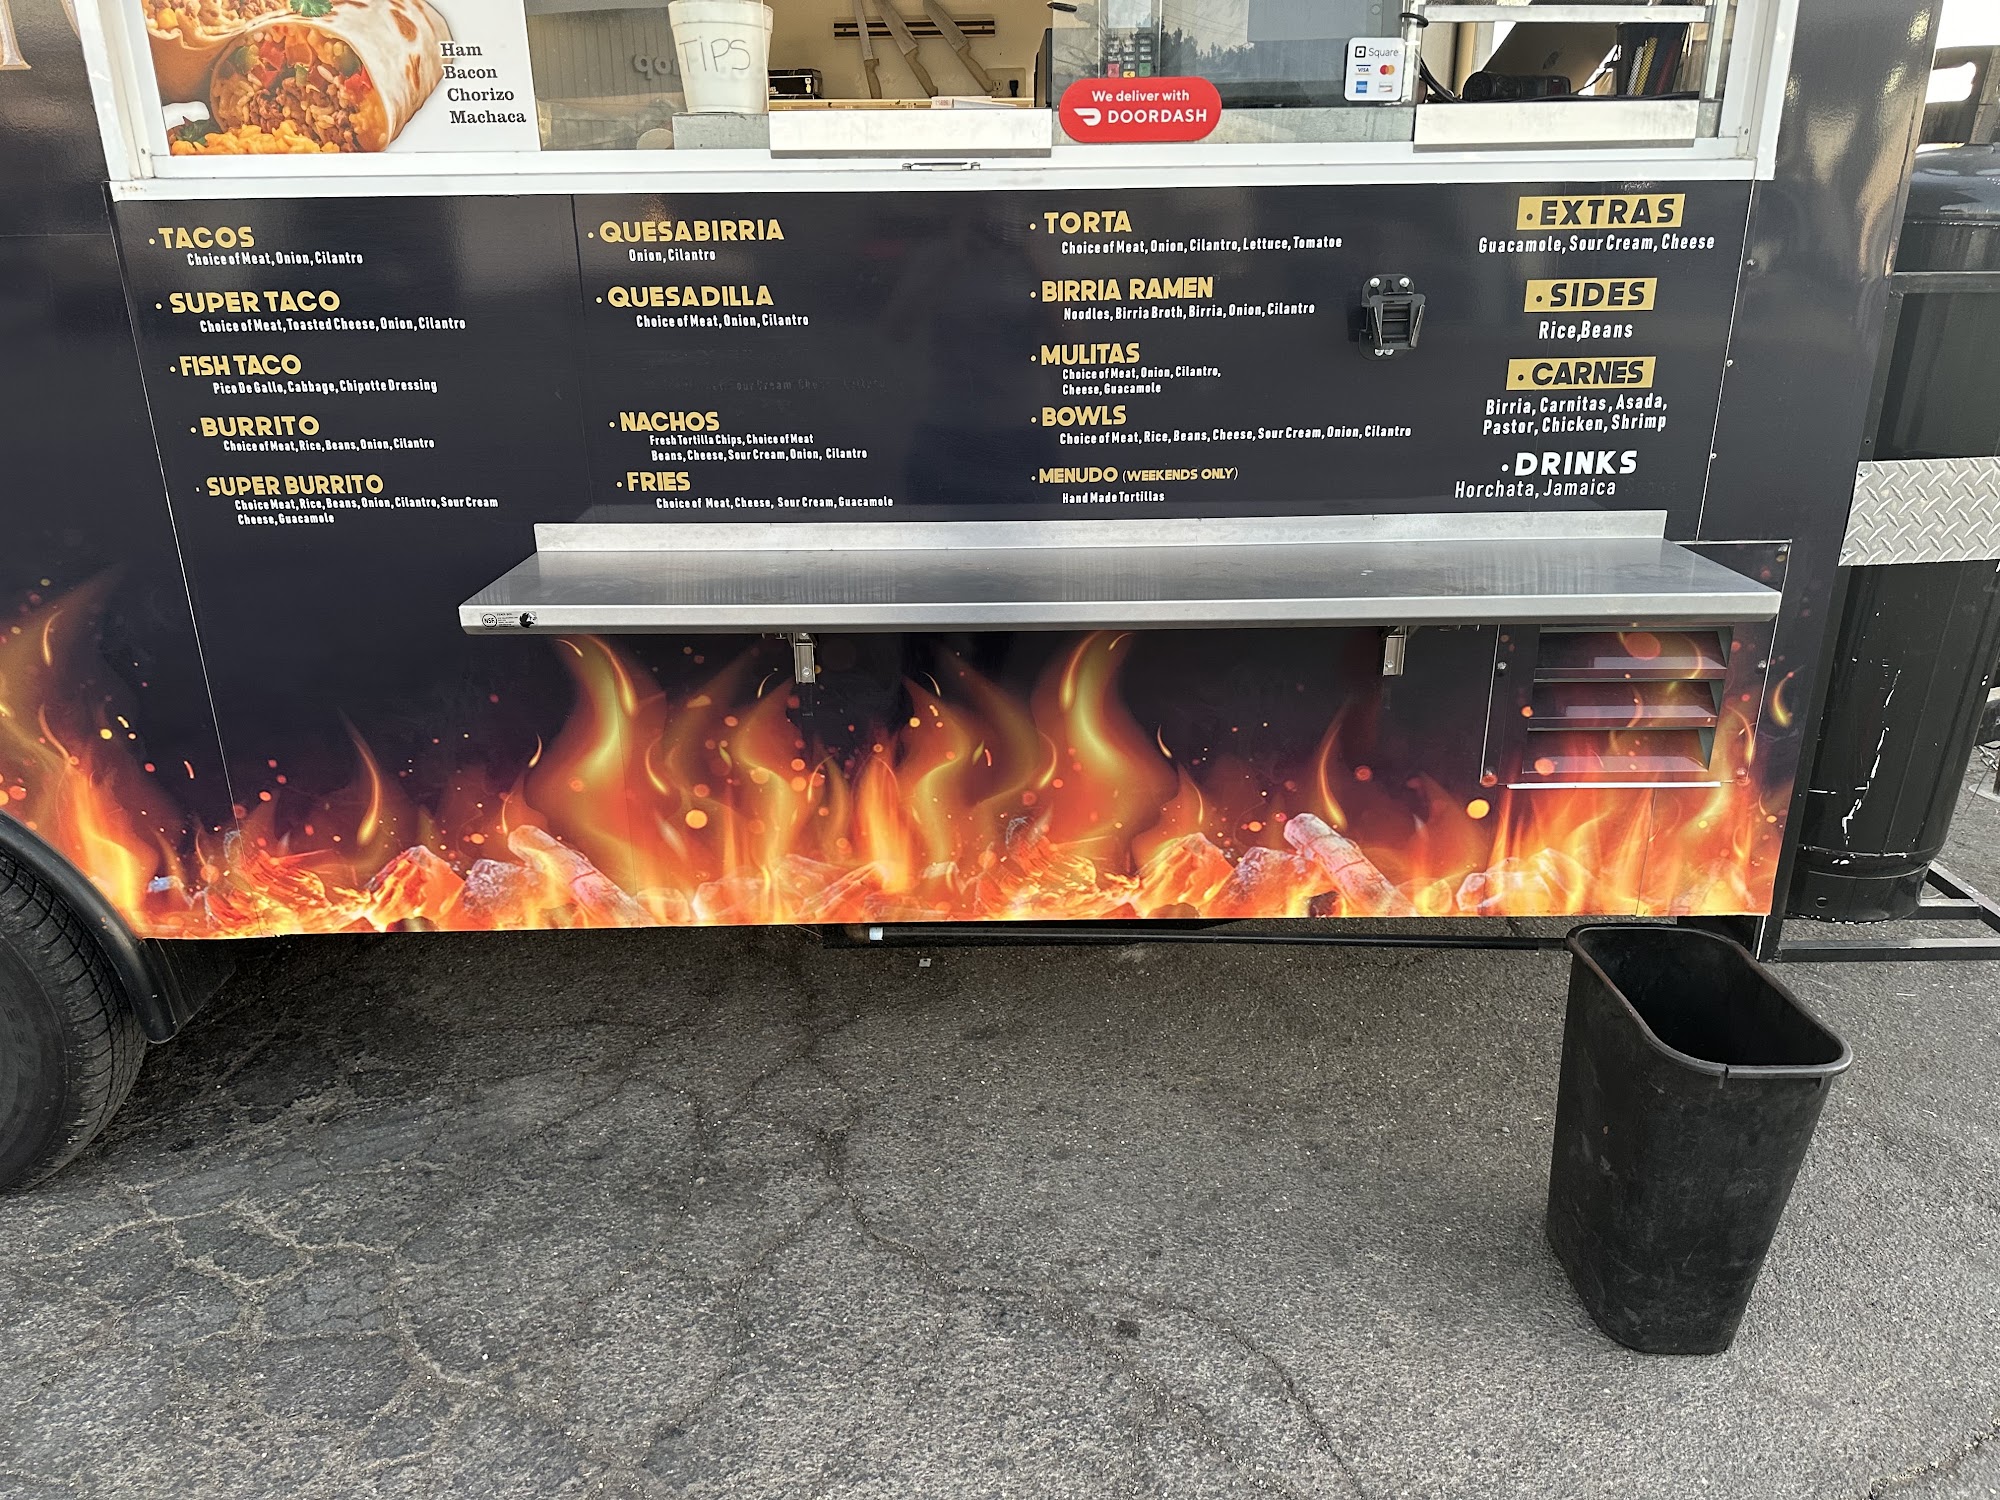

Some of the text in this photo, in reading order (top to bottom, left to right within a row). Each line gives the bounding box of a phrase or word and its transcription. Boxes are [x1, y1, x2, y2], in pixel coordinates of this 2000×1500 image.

[440, 43, 483, 56] Ham
[1369, 48, 1398, 58] Square
[443, 66, 498, 79] Bacon
[447, 87, 514, 102] Chorizo
[1091, 89, 1189, 102] We deliver with
[449, 110, 527, 124] Machaca
[1108, 107, 1207, 125] DOORDASH
[1540, 198, 1675, 225] EXTRAS
[600, 219, 784, 243] QUESABIRRIA
[1044, 211, 1132, 234] TORTA
[158, 227, 254, 248] TACOS
[1062, 236, 1342, 254] Choice of Meat, Onion, Cilantro, Lettuce, Tomatoe
[1479, 233, 1714, 254] Guacamole, Sour Cream, Cheese
[187, 251, 363, 266] Choice of Meat, Onion, Cilantro
[629, 248, 715, 263] Onion, Cilantro
[608, 285, 774, 307] QUESADILLA
[1042, 277, 1213, 302] BIRRIA RAMEN
[1550, 281, 1645, 307] SIDES
[169, 290, 340, 313] SUPER TACO
[1064, 302, 1315, 321] Noodles, Birria Broth, Birria, Onion, Cilantro
[200, 317, 466, 333] Choice of Meat, Toasted Cheese, Onion, Cilantro
[636, 314, 808, 329] Choice of Meat, Onion, Cilantro
[1041, 343, 1140, 365] MULITAS
[179, 354, 301, 376] FISH TACO
[1063, 366, 1221, 380] Choice of Meat, Onion, Cilantro,
[1532, 361, 1644, 386] CARNES
[213, 382, 237, 394] Pico
[238, 382, 252, 393] De
[254, 381, 287, 394] Gallo,
[287, 381, 339, 395] Cabbage,
[388, 379, 437, 393] Dressing
[1063, 382, 1161, 396] Cheese, Guacamole
[1486, 393, 1667, 416] Birria, Carnitas, Asada,
[620, 412, 719, 431] NACHOS
[1042, 405, 1126, 426] BOWLS
[1483, 413, 1666, 436] Pastor, Chicken, Shrimp
[200, 416, 319, 437] BURRITO
[1060, 425, 1411, 444] Choice of Meat, Rice, Beans, Cheese, Sour Cream, Onion, Cilantro
[223, 438, 434, 452] Choice of Meat, Rice, Beans, Onion, Cilantro
[649, 434, 813, 447] Fresh Tortilla Chips, Choice of Meat
[651, 448, 867, 462] Beans, Cheese, Sour Cream, Onion, Cilantro
[1515, 450, 1637, 476] DRINKS
[627, 472, 690, 491] FRIES
[1039, 467, 1238, 483] MENUDO (WEEKENDS ONLY)
[206, 474, 383, 496] SUPER BURRITO
[1455, 478, 1615, 499] Horchata, Jamaica
[235, 496, 498, 511] Choice Meat, Rice, Beans, Onion, Cilantro, Sour Cream
[656, 496, 893, 509] Choice of Meat, Cheese, Sour Cream, Guacamole
[1063, 491, 1165, 503] Hand Made Tortillas
[238, 512, 334, 526] Cheese, Guacamole
